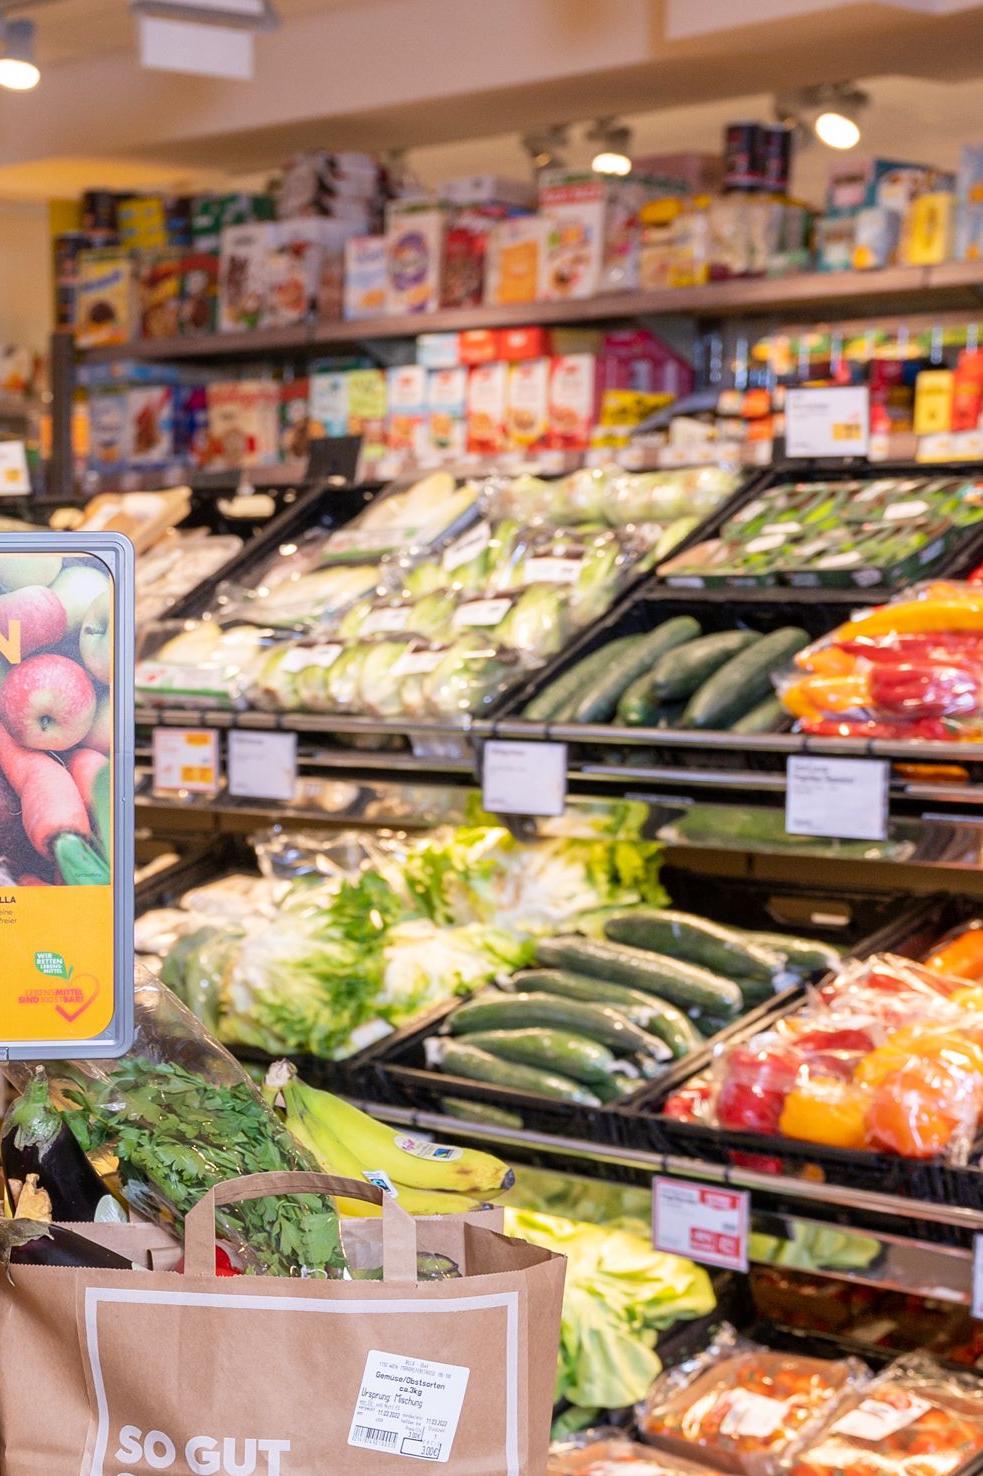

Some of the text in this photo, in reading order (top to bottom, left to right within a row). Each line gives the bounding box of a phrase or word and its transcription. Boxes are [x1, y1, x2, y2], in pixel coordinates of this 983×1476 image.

[18, 996, 39, 1004] SIND
[393, 1393, 424, 1409] Mischung
[114, 1424, 176, 1469] SO
